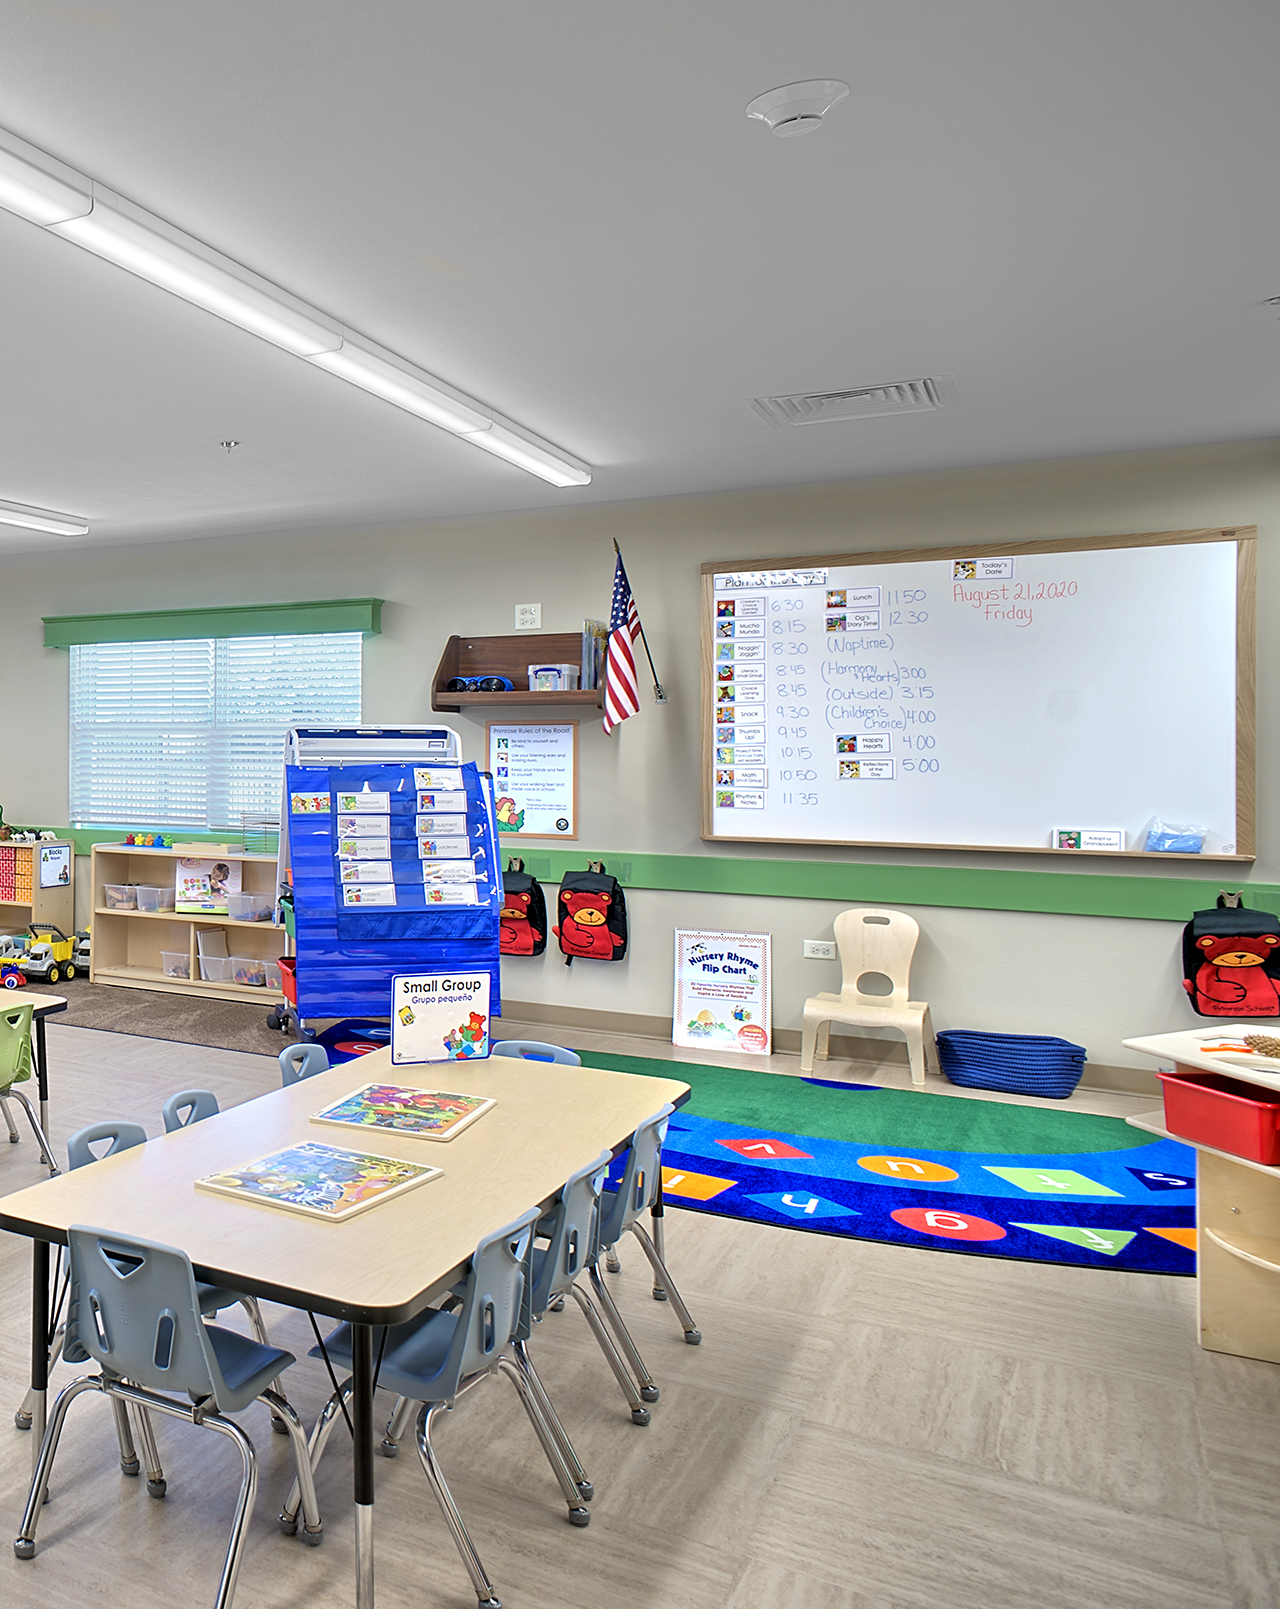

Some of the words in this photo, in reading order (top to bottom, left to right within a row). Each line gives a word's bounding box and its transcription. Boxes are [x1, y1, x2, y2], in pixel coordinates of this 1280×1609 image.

[954, 583, 1009, 609] August
[984, 604, 1033, 628] Friday
[827, 633, 894, 655] (Naptime)
[826, 686, 893, 701] (Outside)
[688, 952, 724, 966] Nursery
[727, 952, 760, 970] Rhyme
[702, 963, 719, 974] Flip
[722, 965, 747, 975] Chart
[403, 980, 438, 994] Small
[442, 979, 481, 992] Group
[412, 996, 436, 1004] Grupo
[438, 993, 473, 1004] pequeño
